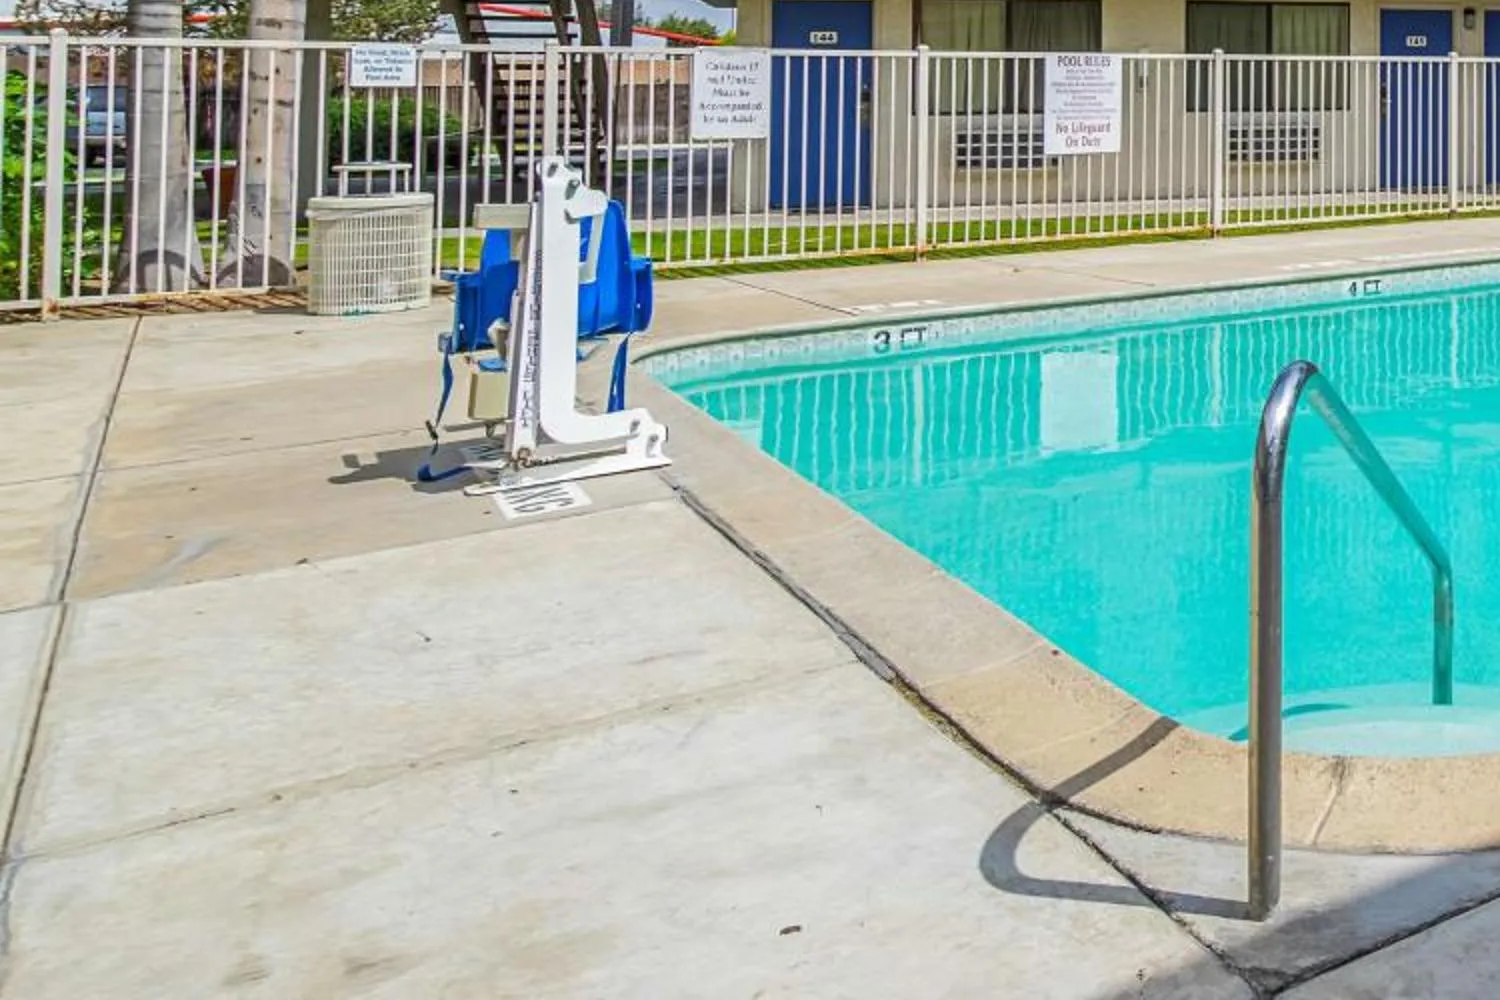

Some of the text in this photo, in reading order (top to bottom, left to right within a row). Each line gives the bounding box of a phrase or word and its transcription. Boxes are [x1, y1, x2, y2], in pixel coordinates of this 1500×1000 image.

[1057, 55, 1111, 68] POOL RULES
[1056, 122, 1069, 134] No
[874, 329, 891, 354] 3
